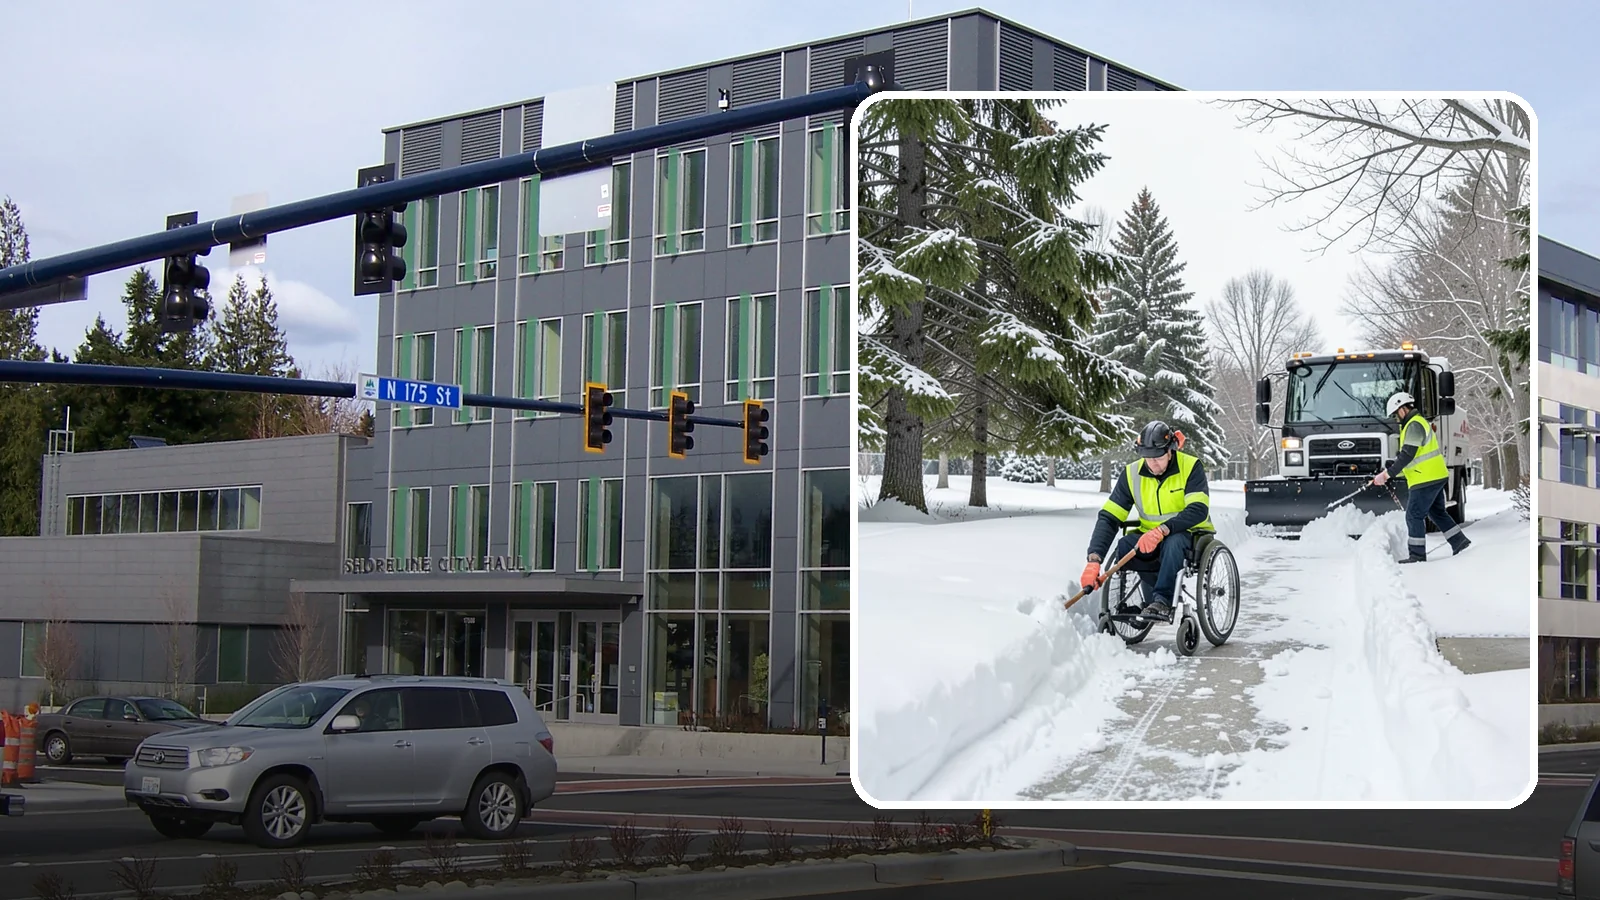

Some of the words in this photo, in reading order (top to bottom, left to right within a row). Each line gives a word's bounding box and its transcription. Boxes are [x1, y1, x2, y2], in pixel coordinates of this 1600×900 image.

[387, 380, 396, 399] N
[405, 382, 427, 403] 175
[436, 386, 451, 406] St
[343, 557, 431, 573] SHORELINE
[438, 556, 475, 572] CITY
[483, 555, 525, 571] HALL
